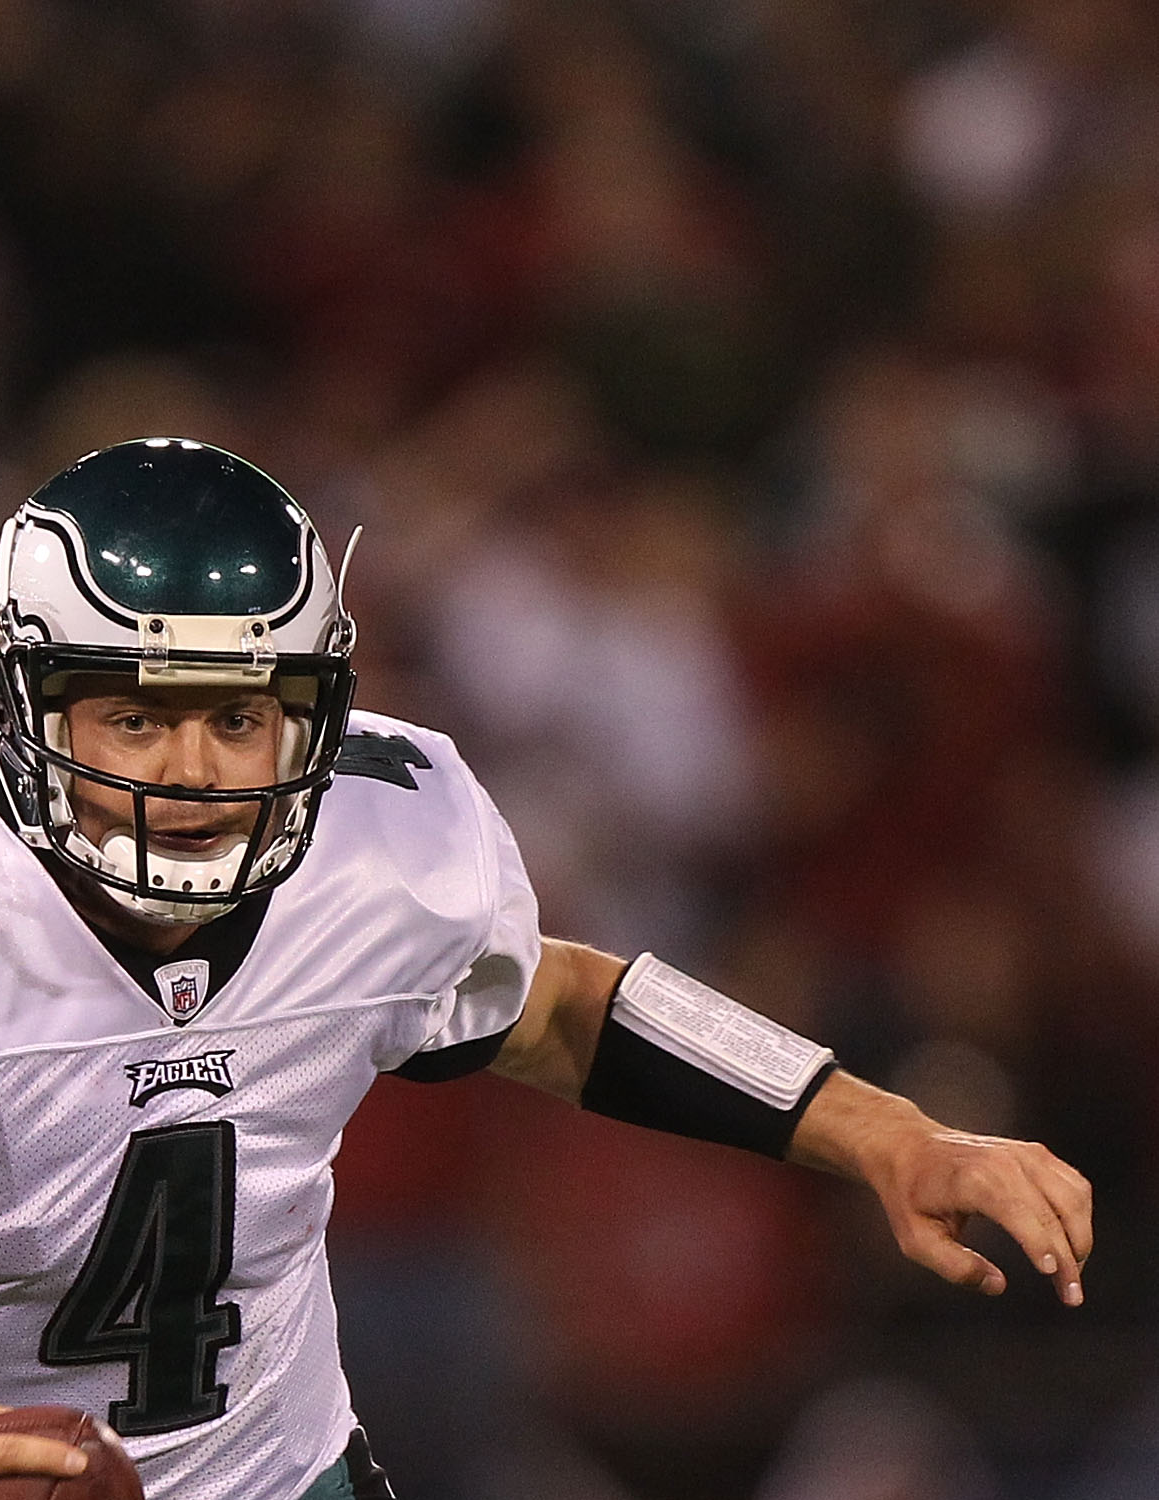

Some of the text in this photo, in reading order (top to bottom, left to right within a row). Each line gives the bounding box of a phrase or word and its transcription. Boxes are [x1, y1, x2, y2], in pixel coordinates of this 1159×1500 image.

[174, 989, 196, 1010] NFL
[126, 1053, 232, 1100] EAGLES
[39, 1120, 241, 1436] 4
